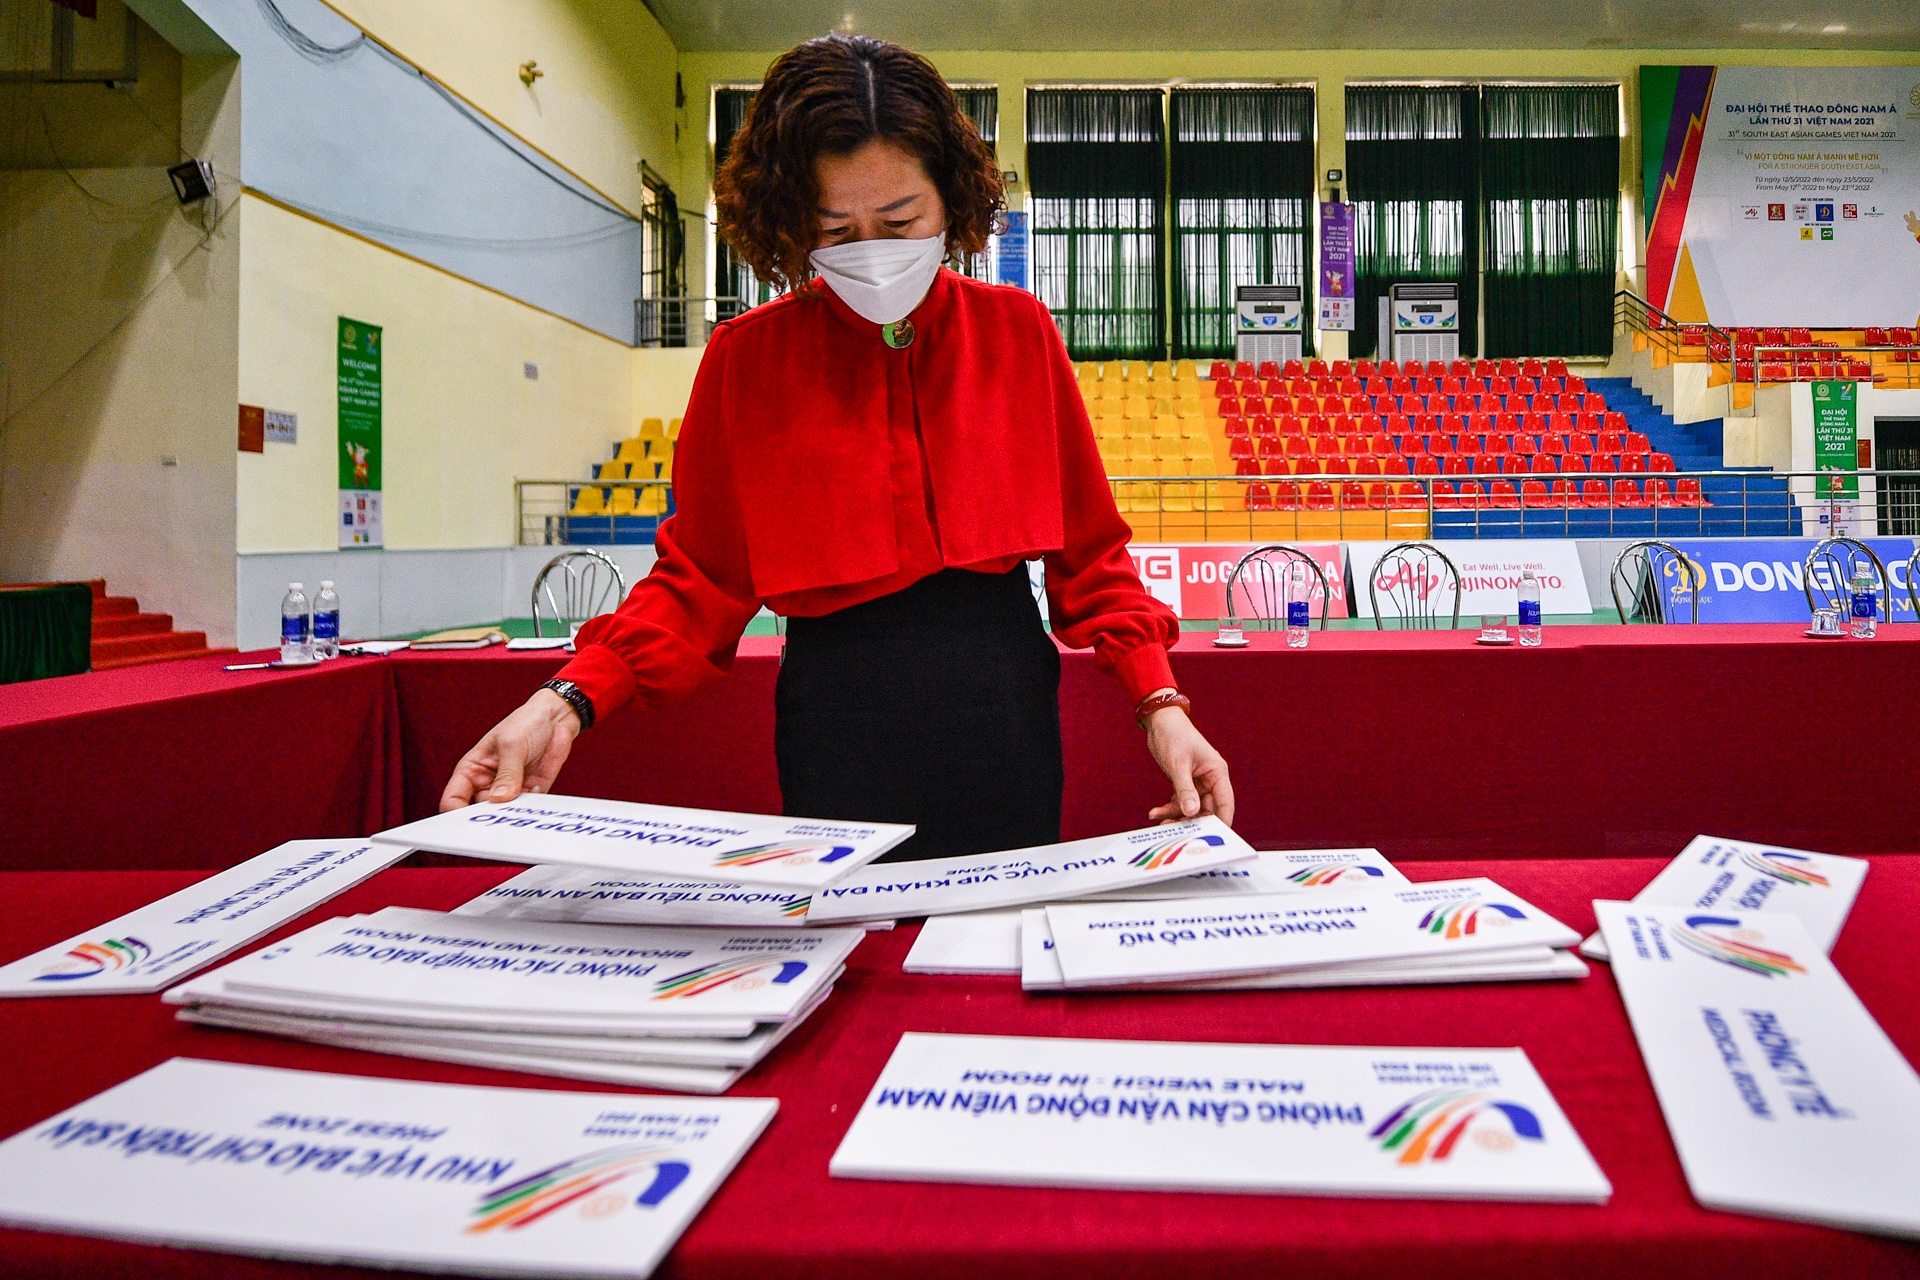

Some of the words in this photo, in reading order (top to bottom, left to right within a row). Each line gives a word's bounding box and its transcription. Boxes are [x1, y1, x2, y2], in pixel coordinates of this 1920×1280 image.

[1726, 104, 1745, 115] ĐẠI
[1748, 104, 1767, 115] HỘI
[1794, 105, 1823, 113] THAO
[1827, 103, 1858, 113] ĐÔNG
[1861, 105, 1887, 113] NAM
[1889, 102, 1897, 113] Á
[1806, 116, 1828, 125] VIỆT
[1797, 153, 1815, 161] NAM
[342, 357, 377, 371] WELCOME
[1825, 443, 1845, 451] 2021
[1463, 563, 1476, 571] Eat
[1479, 563, 1501, 572] Well,
[1503, 563, 1521, 571] Live
[1449, 575, 1562, 591] AJINOMTO
[500, 807, 559, 817] ROOM
[470, 814, 541, 827] BÁO
[559, 811, 682, 829] CONFERENCE
[682, 826, 749, 837] PRESS
[1004, 861, 1035, 869] VIP
[1063, 856, 1116, 871] KHU
[948, 865, 1003, 876] ZONE
[957, 874, 1002, 885] VIP
[485, 888, 552, 898] NINH
[551, 890, 593, 899] AN
[590, 890, 648, 901] BAN
[708, 893, 797, 904] PHÒNG
[1166, 911, 1283, 925] CHANGING
[1287, 906, 1369, 918] FEMALE
[1090, 919, 1157, 930] ROOM
[341, 929, 420, 942] ROOM
[1204, 926, 1271, 939] THAY
[419, 936, 498, 948] MEDIA
[494, 942, 549, 952] AND
[546, 946, 693, 959] BROADCAST
[960, 1070, 1055, 1087] ROOM
[1058, 1074, 1091, 1087] IN
[1223, 1079, 1305, 1094] MALE
[879, 1088, 949, 1114] NAM
[255, 1114, 350, 1135] ZONE
[347, 1122, 449, 1143] PRESS
[424, 1157, 517, 1184] KHU
